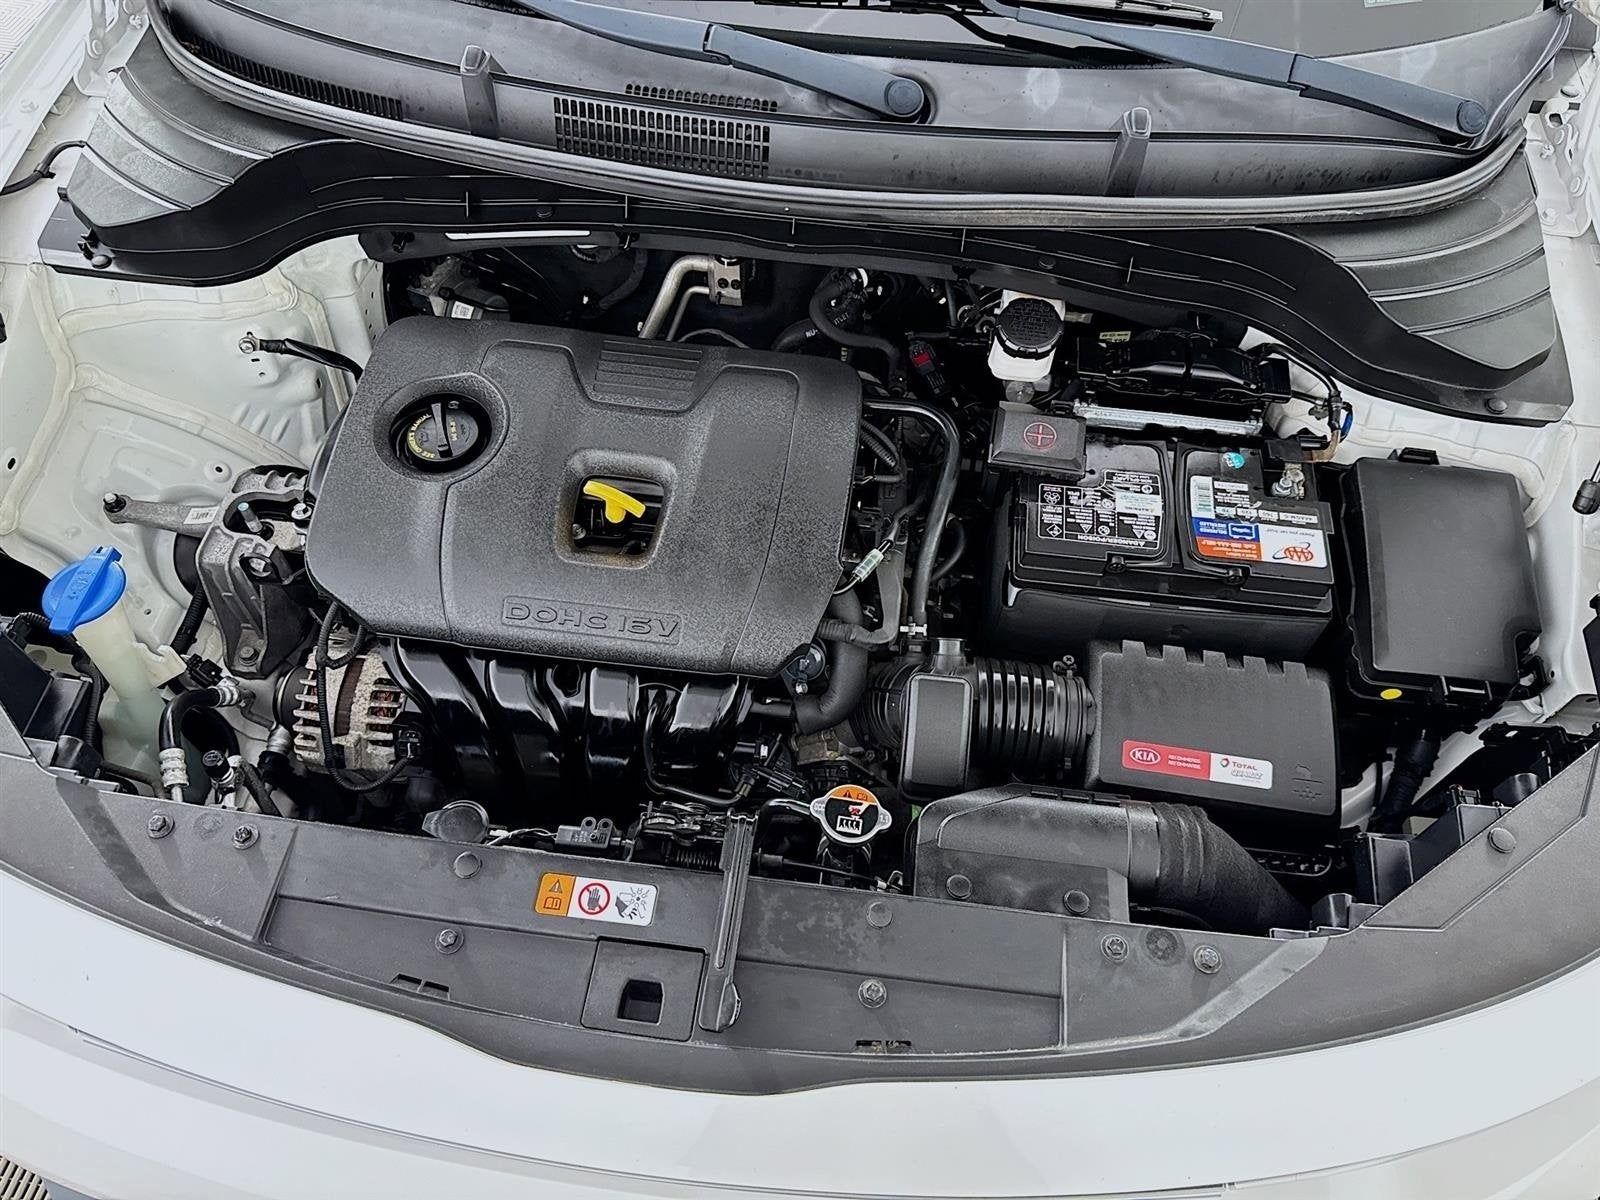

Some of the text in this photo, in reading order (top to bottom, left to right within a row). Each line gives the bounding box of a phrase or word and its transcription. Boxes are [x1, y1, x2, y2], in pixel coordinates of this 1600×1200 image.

[410, 413, 432, 431] MANUAL
[1285, 547, 1312, 561] AAA
[504, 602, 679, 638] DOHC 16V
[1135, 752, 1155, 762] KIA
[1232, 761, 1258, 771] TOTAL
